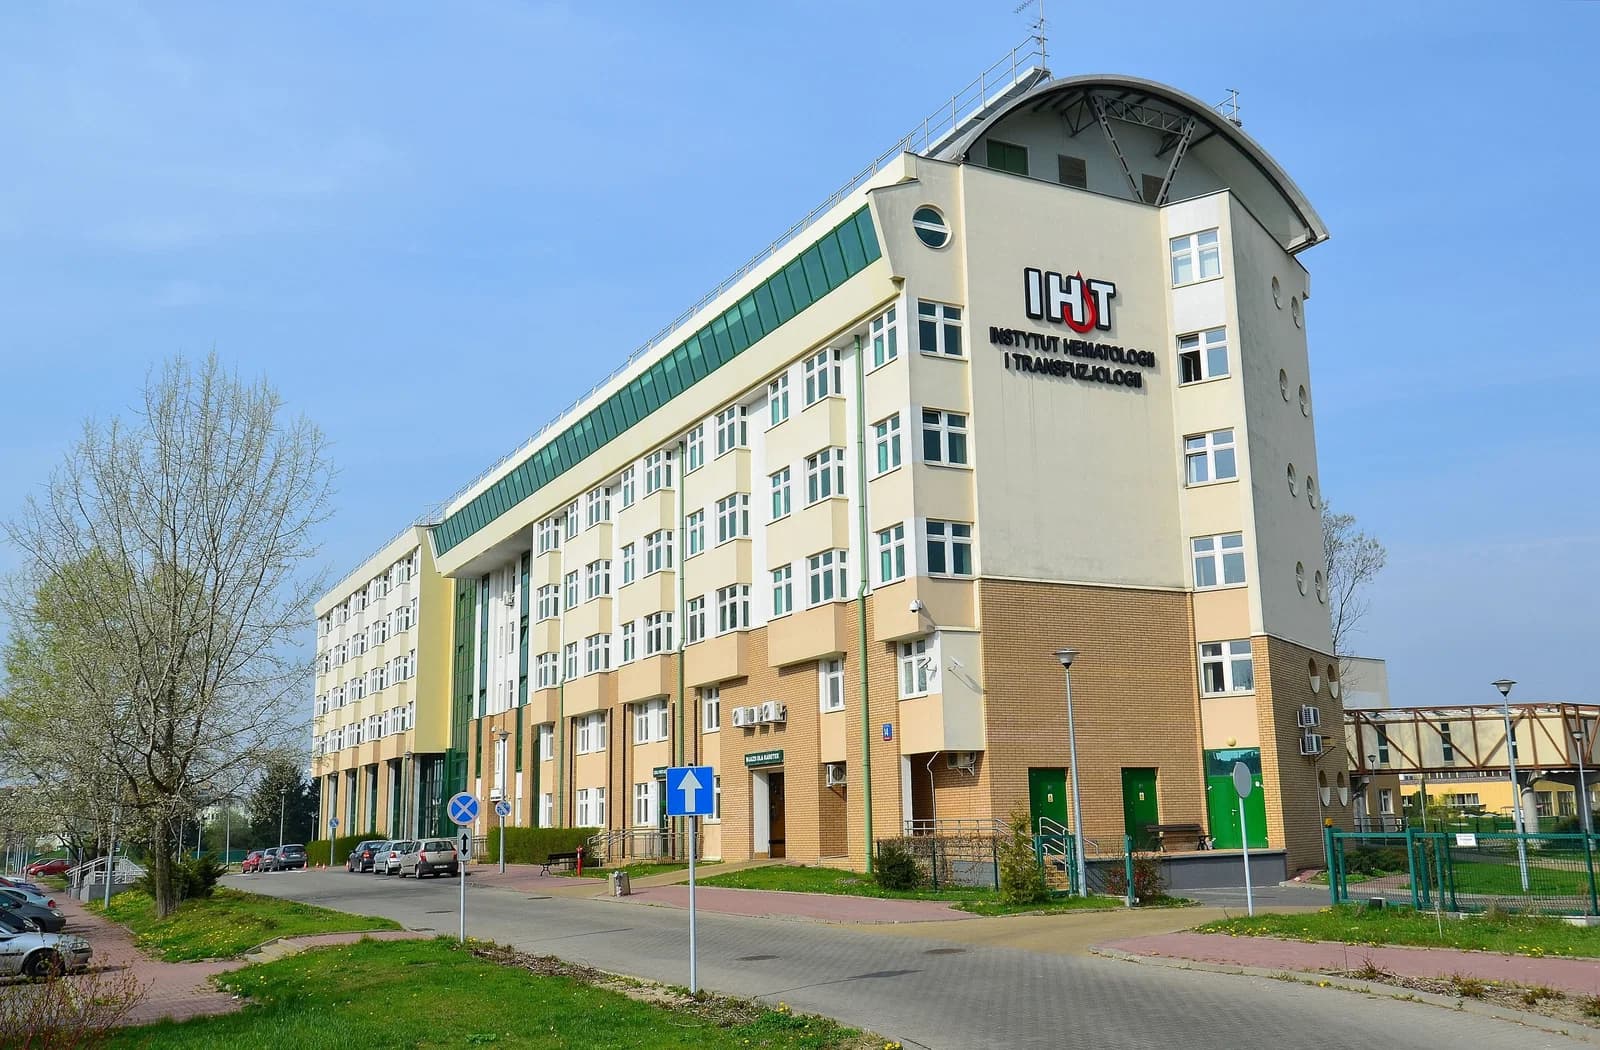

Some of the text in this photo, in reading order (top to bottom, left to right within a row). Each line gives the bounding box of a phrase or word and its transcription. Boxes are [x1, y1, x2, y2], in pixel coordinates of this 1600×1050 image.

[989, 326, 1155, 368] INSTYTUT HEMATOLOGII
[1004, 352, 1142, 388] I TRANSFUZJOLOGII
